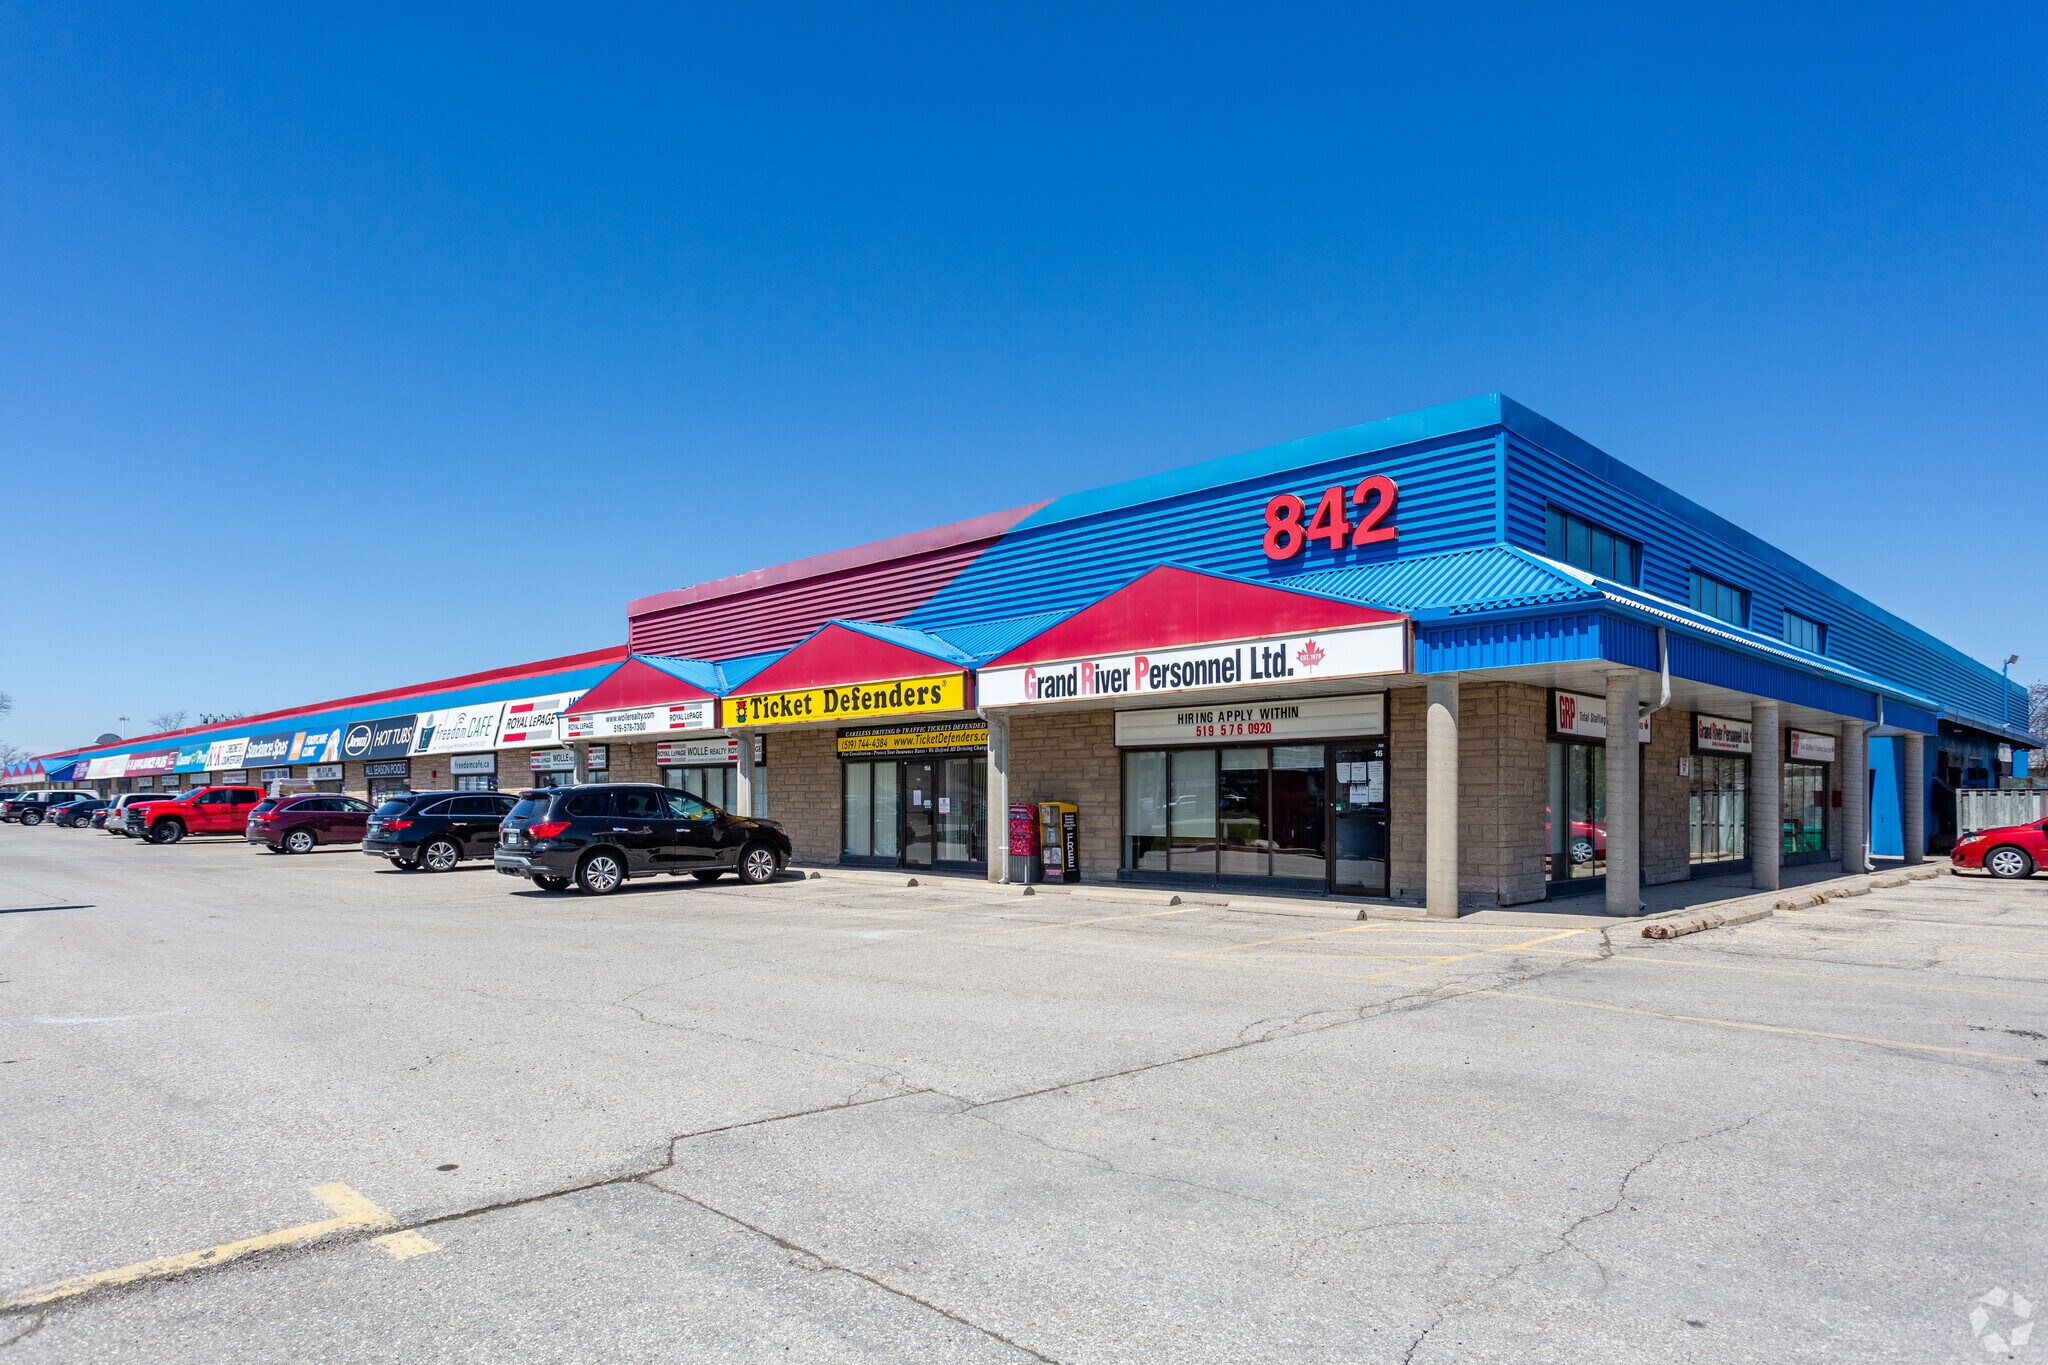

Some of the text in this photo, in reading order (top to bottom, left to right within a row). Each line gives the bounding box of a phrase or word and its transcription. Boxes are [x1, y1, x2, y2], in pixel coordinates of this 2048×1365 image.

[1263, 475, 1399, 560] 842
[1024, 643, 1293, 699] Grand River Personnel Ltd.
[750, 693, 812, 719] Ticket
[1559, 695, 1575, 729] GRP
[1579, 711, 1589, 722] Total
[606, 712, 655, 723] www.wollerealty.com
[669, 713, 684, 721] ROYAL
[1177, 706, 1299, 725] HIRING APPLY WITHIN
[506, 716, 527, 730] ROYAL
[613, 722, 646, 732] 519-578-7300
[845, 729, 872, 737] CARELESS
[872, 728, 896, 736] DRIVING
[901, 726, 926, 734] TRAFFIC
[927, 724, 952, 732] TICKETS
[952, 722, 986, 730] DEFENDED
[1196, 725, 1214, 736] 519
[1248, 722, 1271, 734] 0920
[304, 733, 329, 746] FOOTCARE
[374, 729, 392, 746] HOT
[392, 727, 412, 745] TUBS
[246, 740, 273, 759] Sundance
[273, 739, 289, 760] Spas
[841, 739, 856, 750] (519)
[858, 738, 888, 749] 744-4384
[301, 745, 317, 757] CLINIC
[553, 753, 569, 762] WOLLE
[657, 749, 670, 757] ROYAL
[687, 747, 708, 756] WOLLE
[365, 763, 405, 775] ALL SEASON POOLS
[454, 760, 490, 770] freedomcafe.ca
[1067, 833, 1075, 867] FREE
